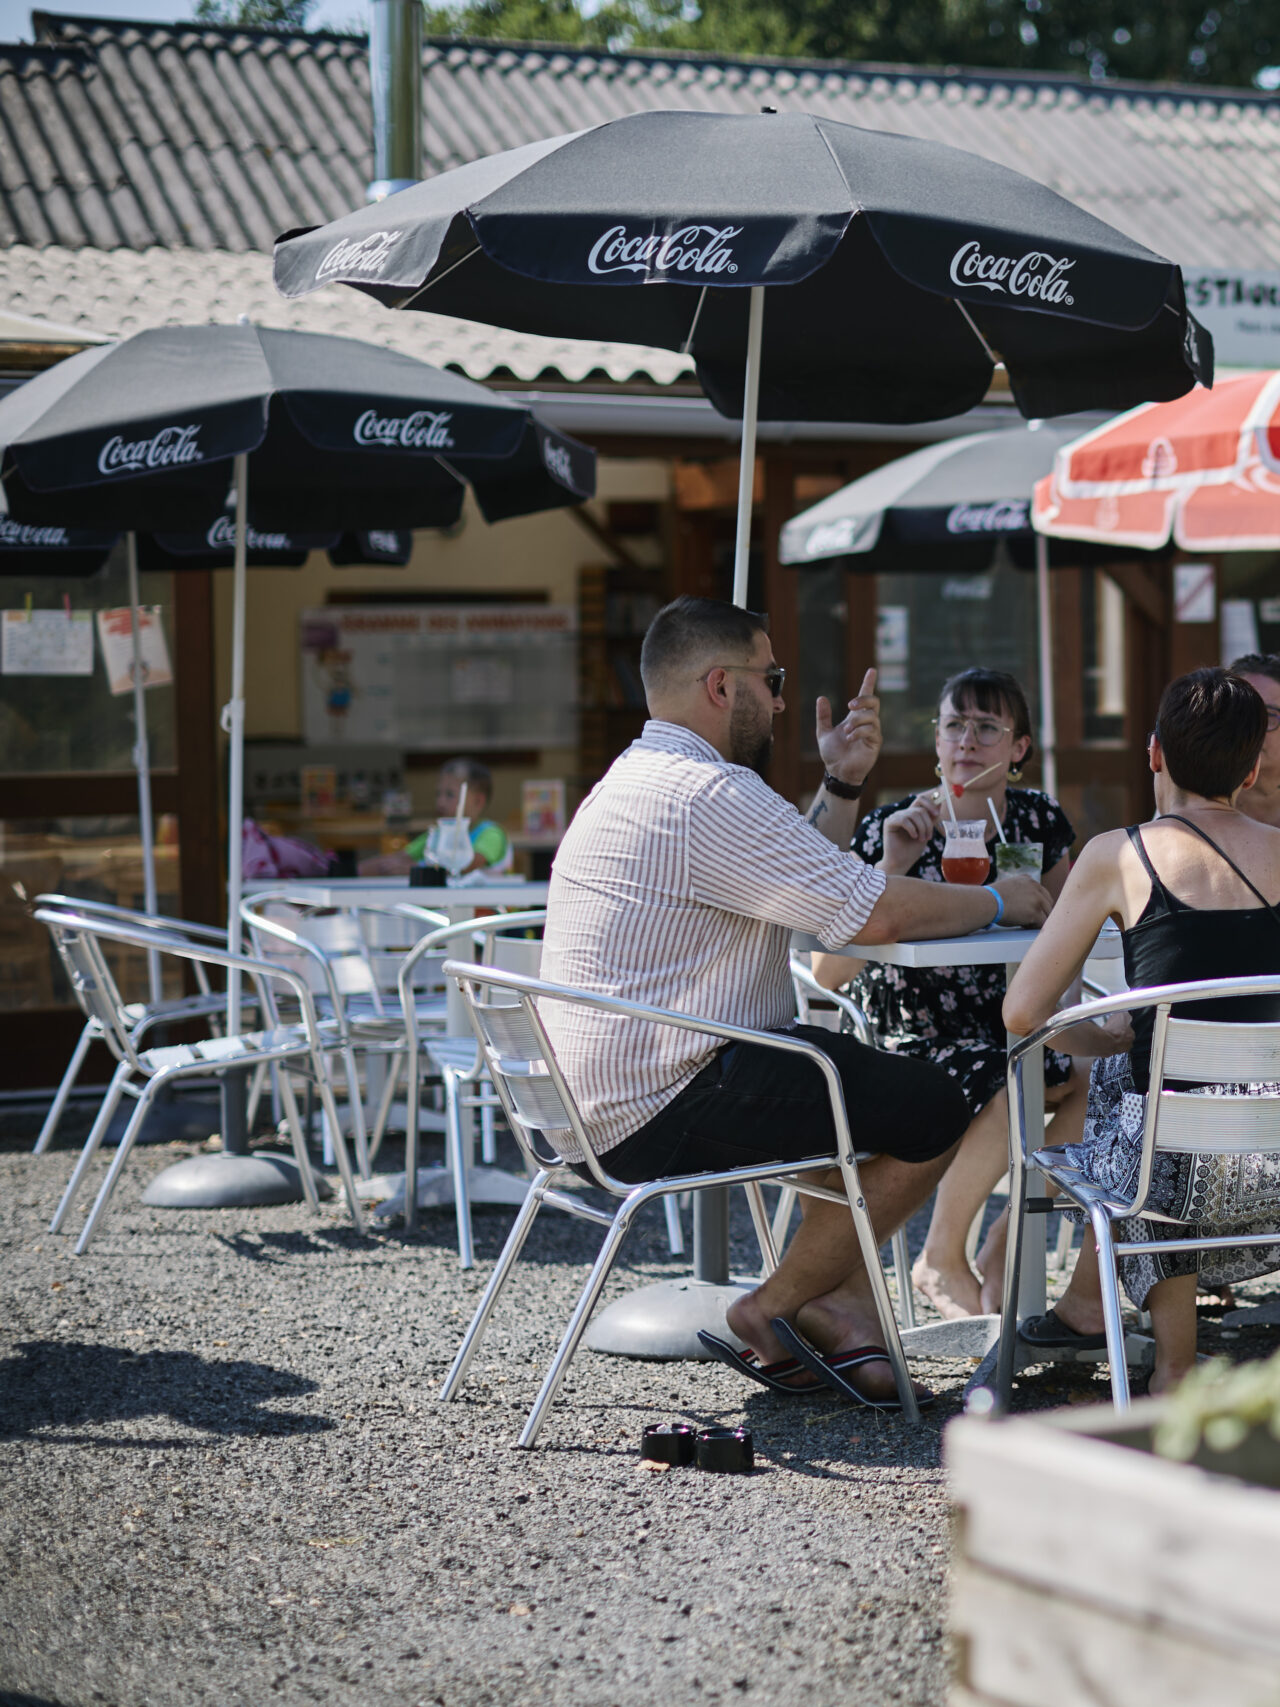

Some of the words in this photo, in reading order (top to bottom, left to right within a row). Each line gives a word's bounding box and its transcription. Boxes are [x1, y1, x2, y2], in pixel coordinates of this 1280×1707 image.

[588, 225, 744, 275] Coca-Cola
[950, 241, 1077, 306] Coca-Cola
[98, 424, 204, 475] Coca-Cola
[353, 409, 455, 448] Coca-Cola
